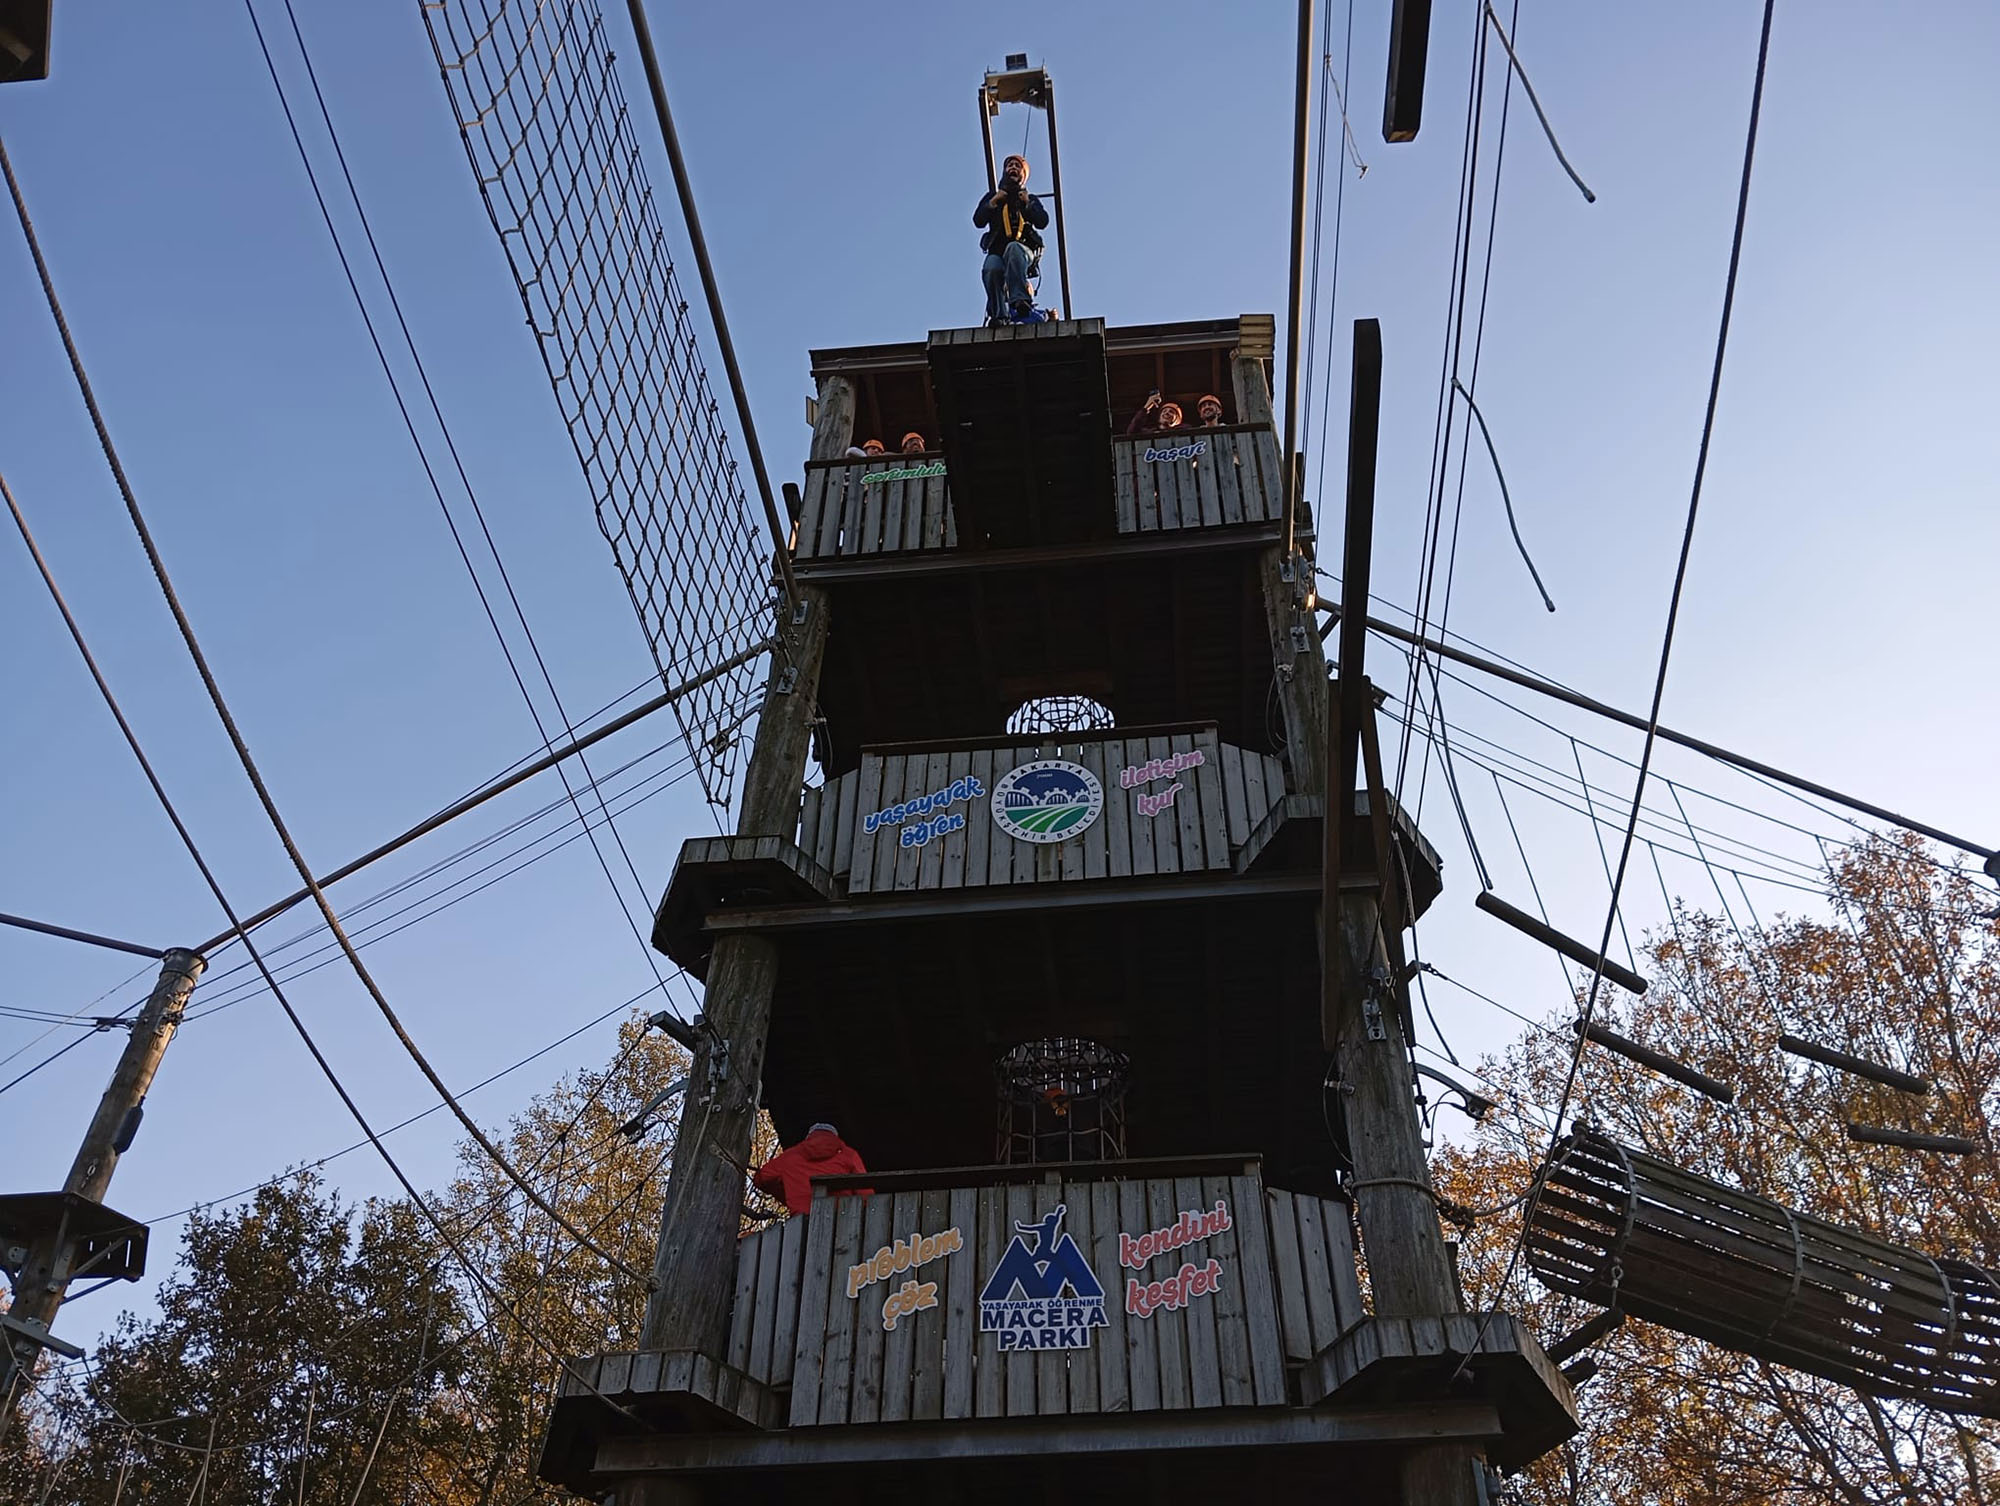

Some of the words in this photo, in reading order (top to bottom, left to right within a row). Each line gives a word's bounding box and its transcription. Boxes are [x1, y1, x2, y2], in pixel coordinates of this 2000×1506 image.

[861, 463, 947, 484] sorumlulu
[1010, 763, 1083, 780] SAKARYA
[1121, 751, 1205, 789] iletişim
[864, 776, 985, 833] yaşayarak
[1138, 783, 1183, 816] kur
[901, 814, 965, 847] öğren
[847, 1227, 963, 1298] problem
[882, 1281, 938, 1330] çöz
[1126, 1260, 1222, 1318] keşfet
[982, 1308, 1107, 1329] MACERA
[1000, 1327, 1088, 1350] PARKI
